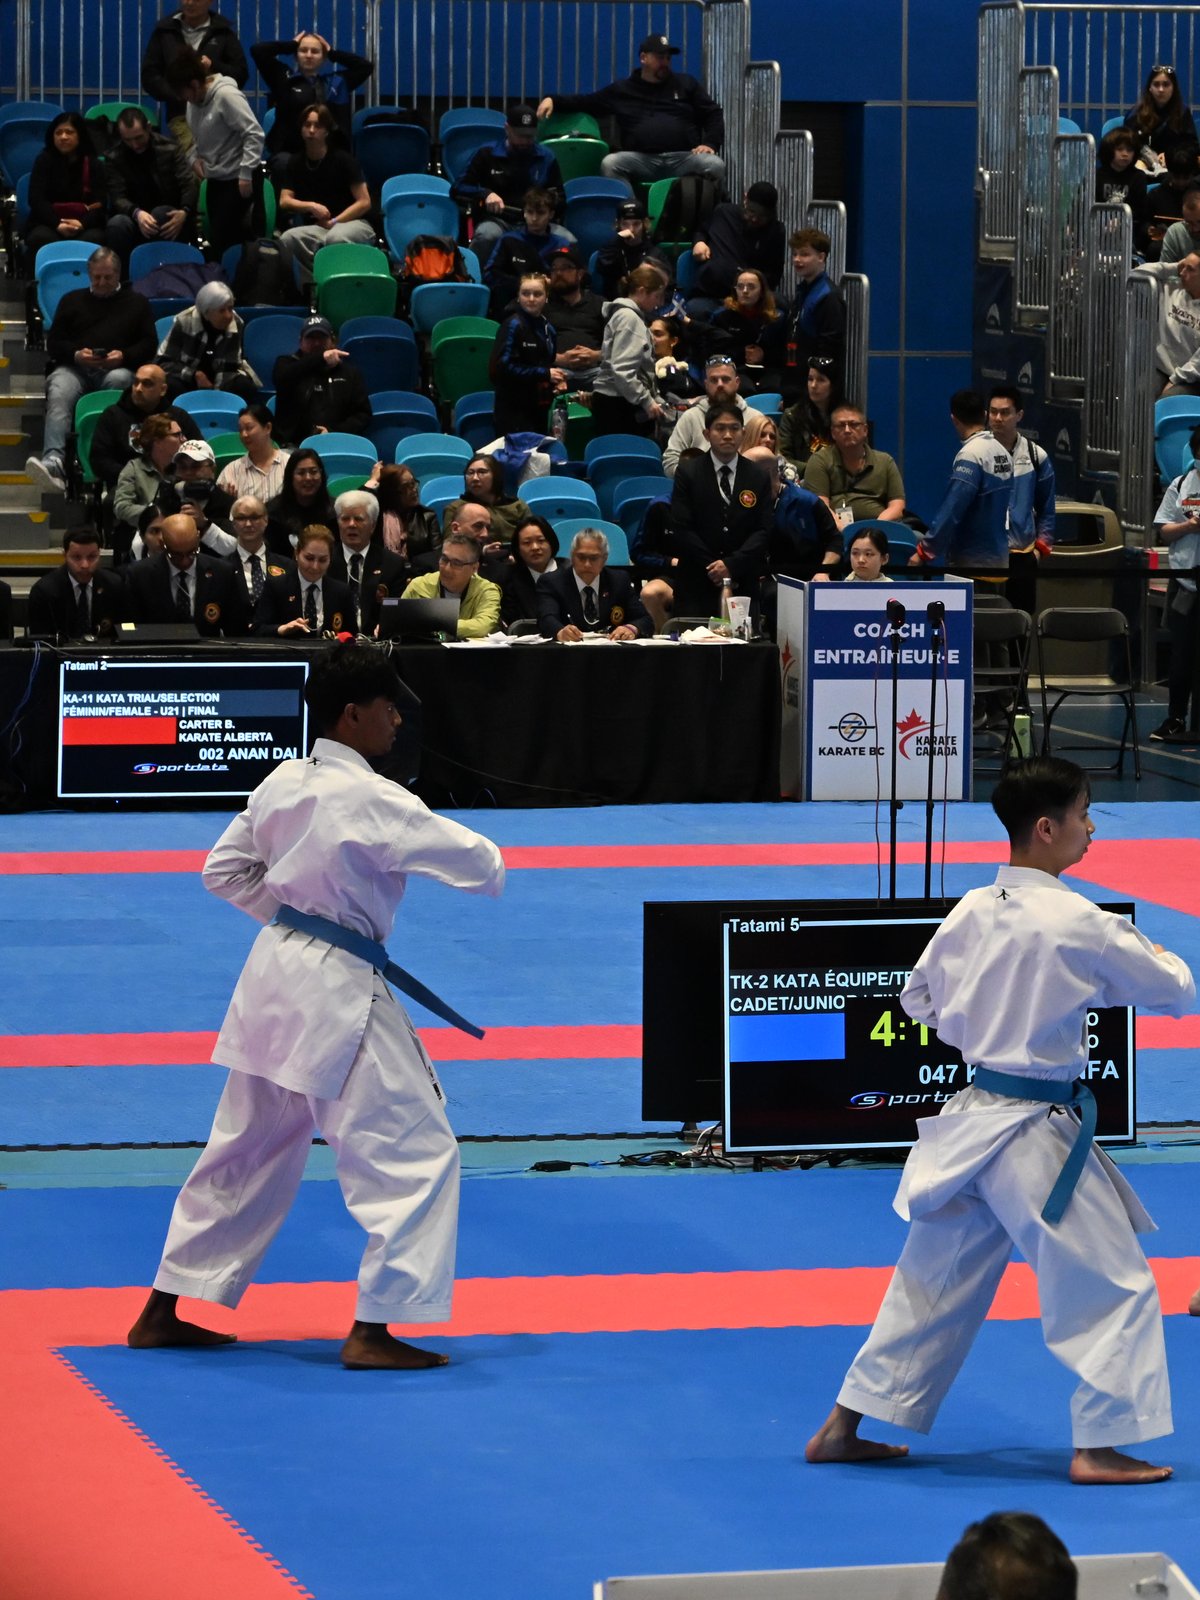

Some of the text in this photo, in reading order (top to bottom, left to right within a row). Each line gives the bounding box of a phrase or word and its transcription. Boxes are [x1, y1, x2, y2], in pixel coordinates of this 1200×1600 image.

[854, 623, 925, 638] COACH
[64, 661, 107, 671] Tatami 2
[63, 693, 220, 703] KA-11 KATA TRIAL/SELECTION
[63, 705, 151, 716] FÉMININ/FEMALE
[160, 706, 180, 716] U21
[188, 706, 218, 716] FINAL
[179, 720, 235, 729] CARTER B.
[179, 732, 273, 742] KARATE ALBERTA
[916, 736, 957, 746] KARATE
[199, 748, 224, 760] 002
[228, 748, 268, 760] ANAN
[819, 747, 885, 756] KARATE BC
[729, 918, 800, 933] Tatami 5
[730, 974, 769, 989] TK-2
[774, 973, 820, 988] KATA
[730, 995, 846, 1012] CADET/JUNIO
[919, 1065, 958, 1084] 047
